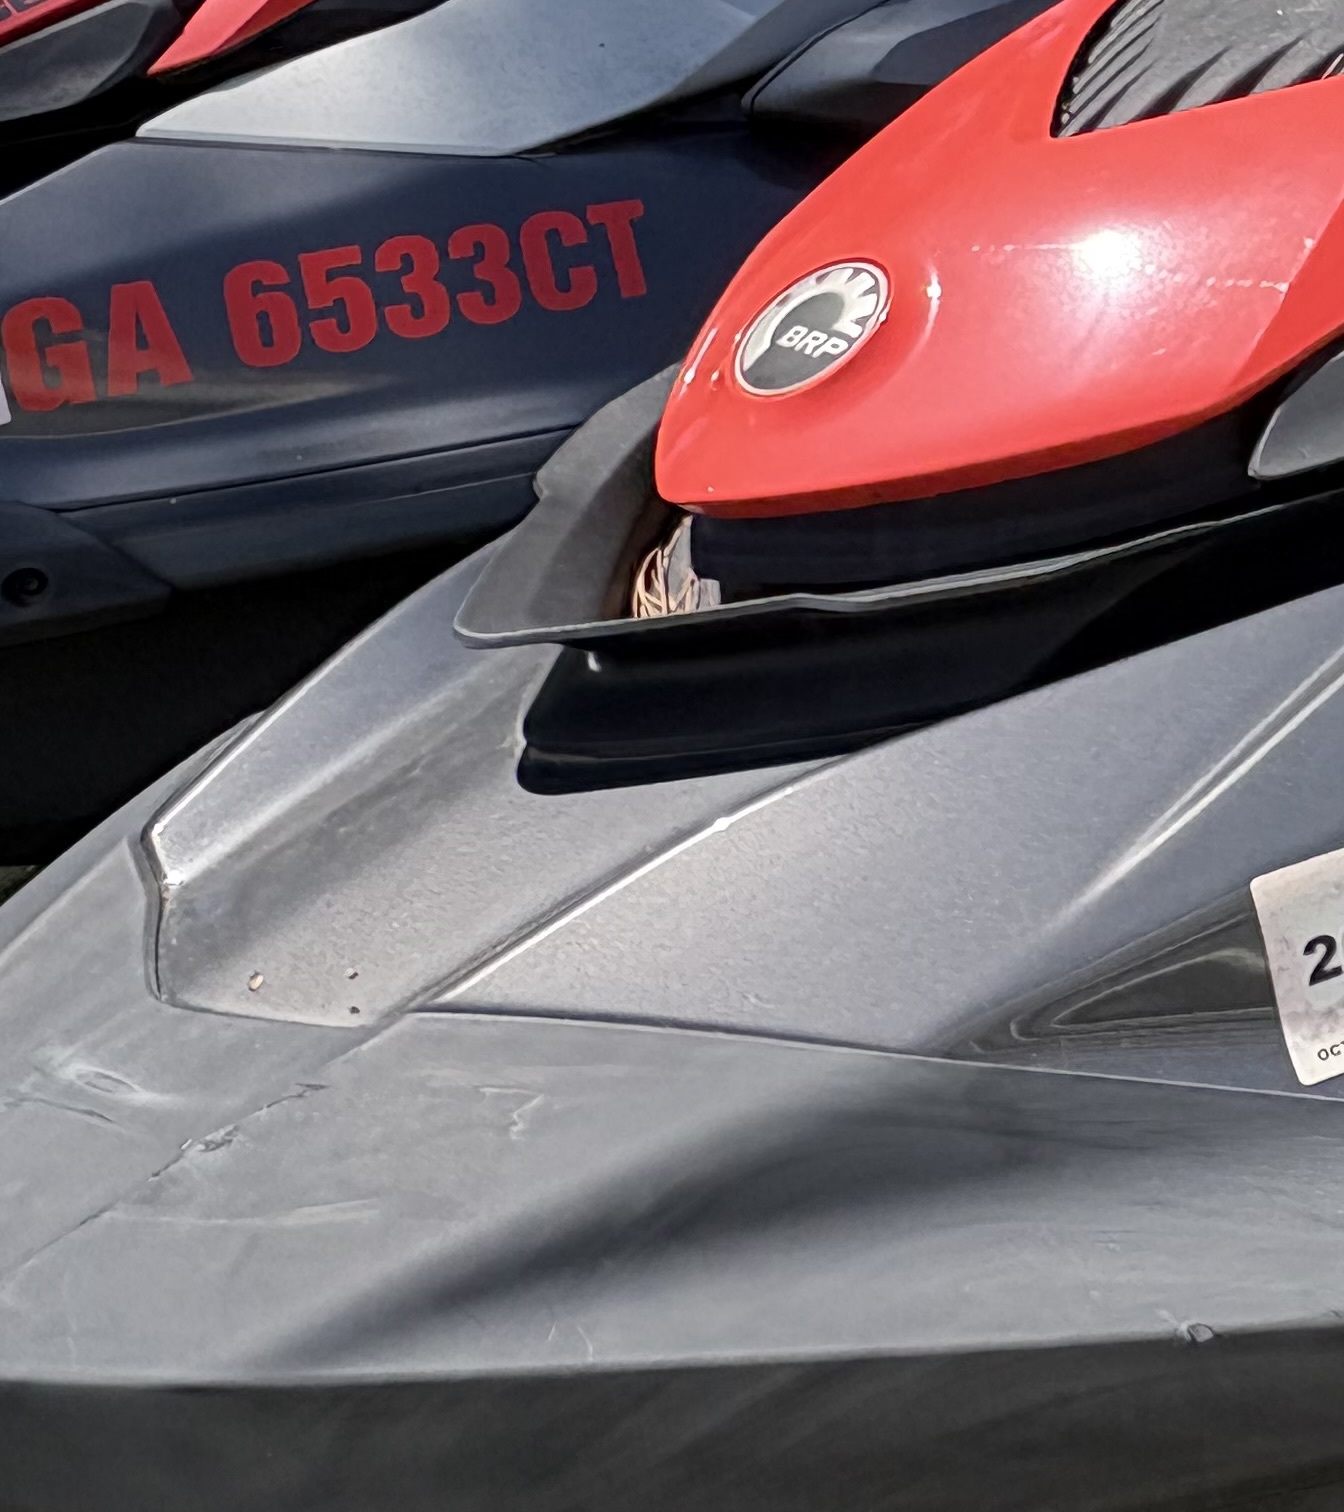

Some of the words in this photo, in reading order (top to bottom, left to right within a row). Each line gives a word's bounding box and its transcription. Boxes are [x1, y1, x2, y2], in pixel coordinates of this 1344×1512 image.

[1, 280, 193, 413] GA
[224, 199, 646, 368] 6533CT
[775, 325, 849, 359] BRP
